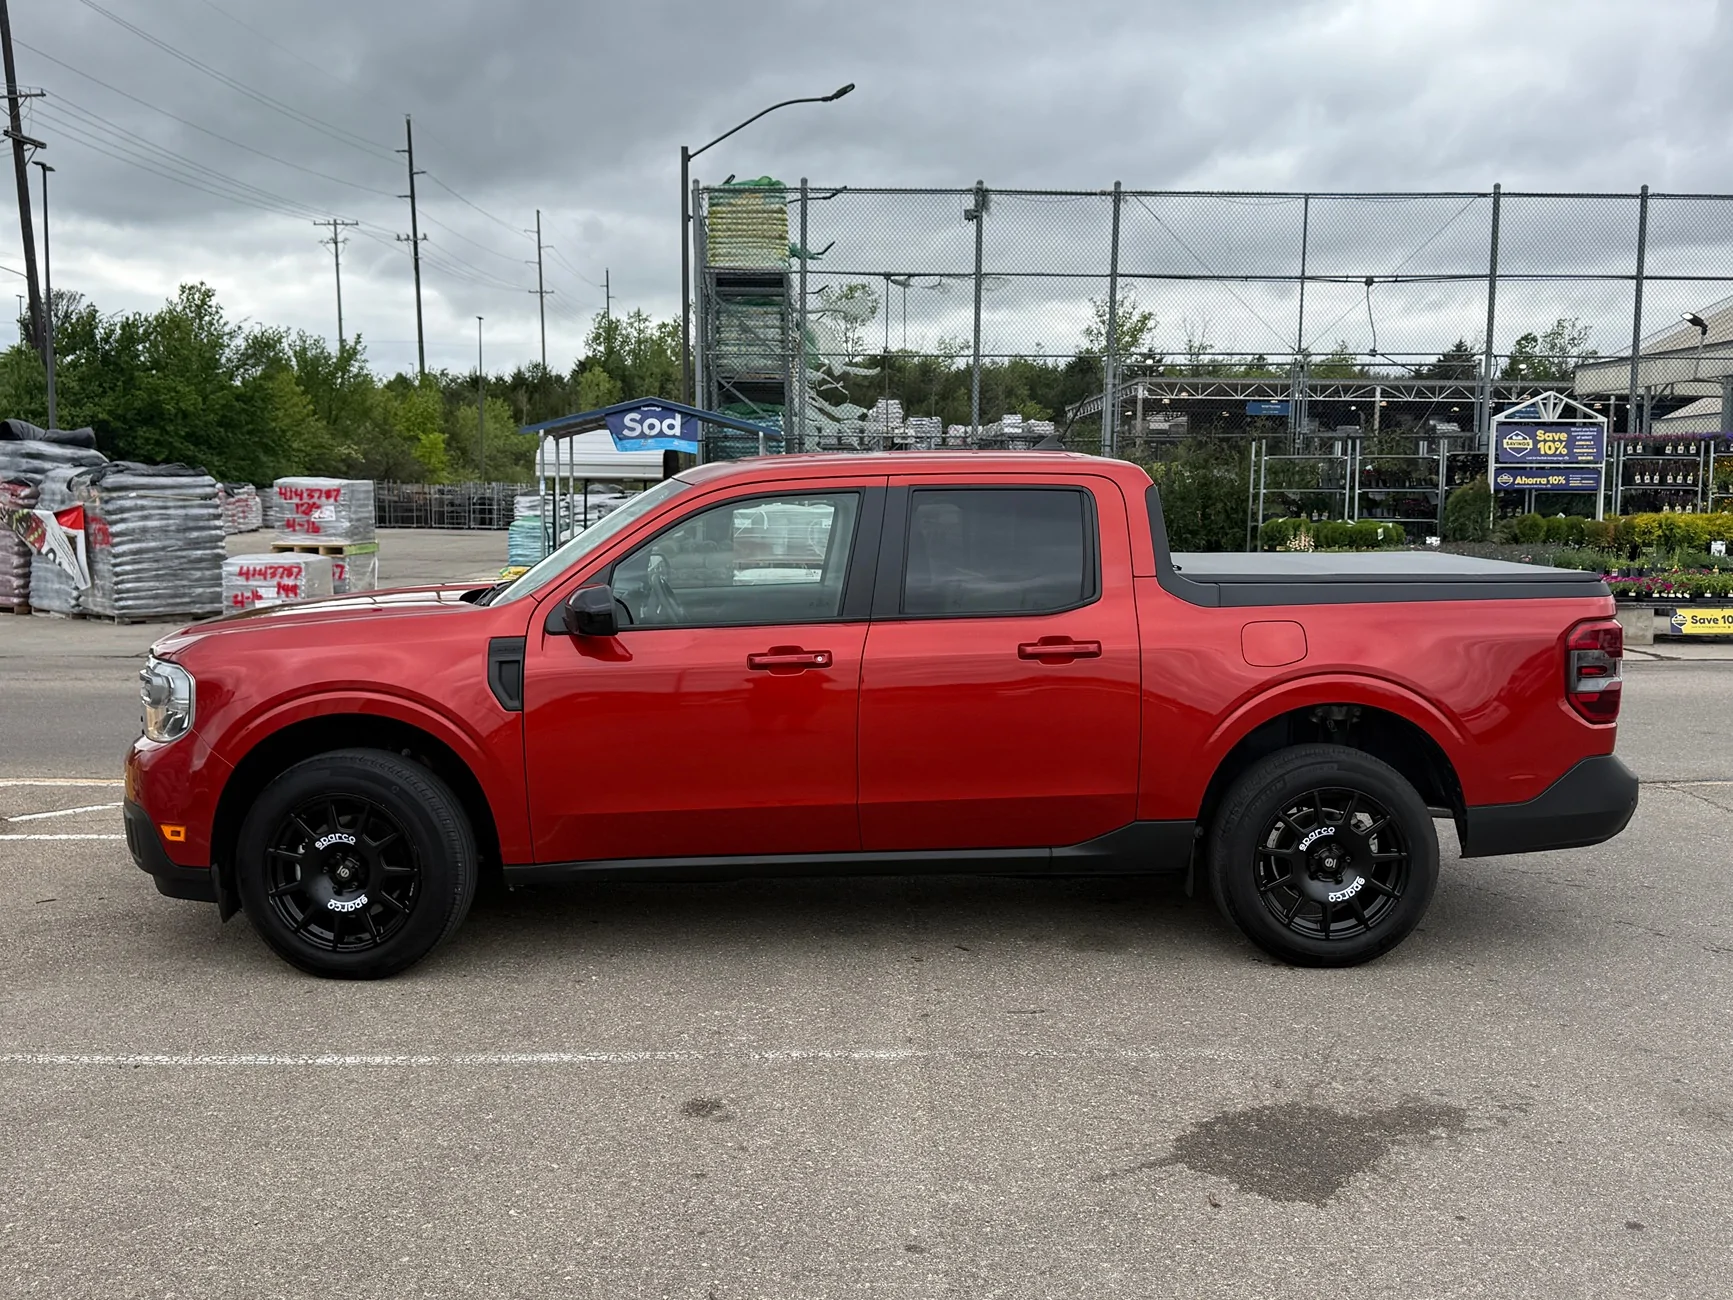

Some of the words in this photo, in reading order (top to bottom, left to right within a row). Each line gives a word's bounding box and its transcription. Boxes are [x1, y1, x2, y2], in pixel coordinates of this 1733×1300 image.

[622, 412, 682, 437] Sod
[1536, 429, 1568, 441] Save
[1537, 441, 1568, 455] 10%
[1514, 476, 1547, 485] Ahorra
[1548, 476, 1566, 485] 10%
[1691, 615, 1719, 624] Save
[315, 833, 356, 850] sparco
[1299, 827, 1335, 851] sparco
[1328, 876, 1366, 902] sparco
[327, 894, 368, 912] sparco
